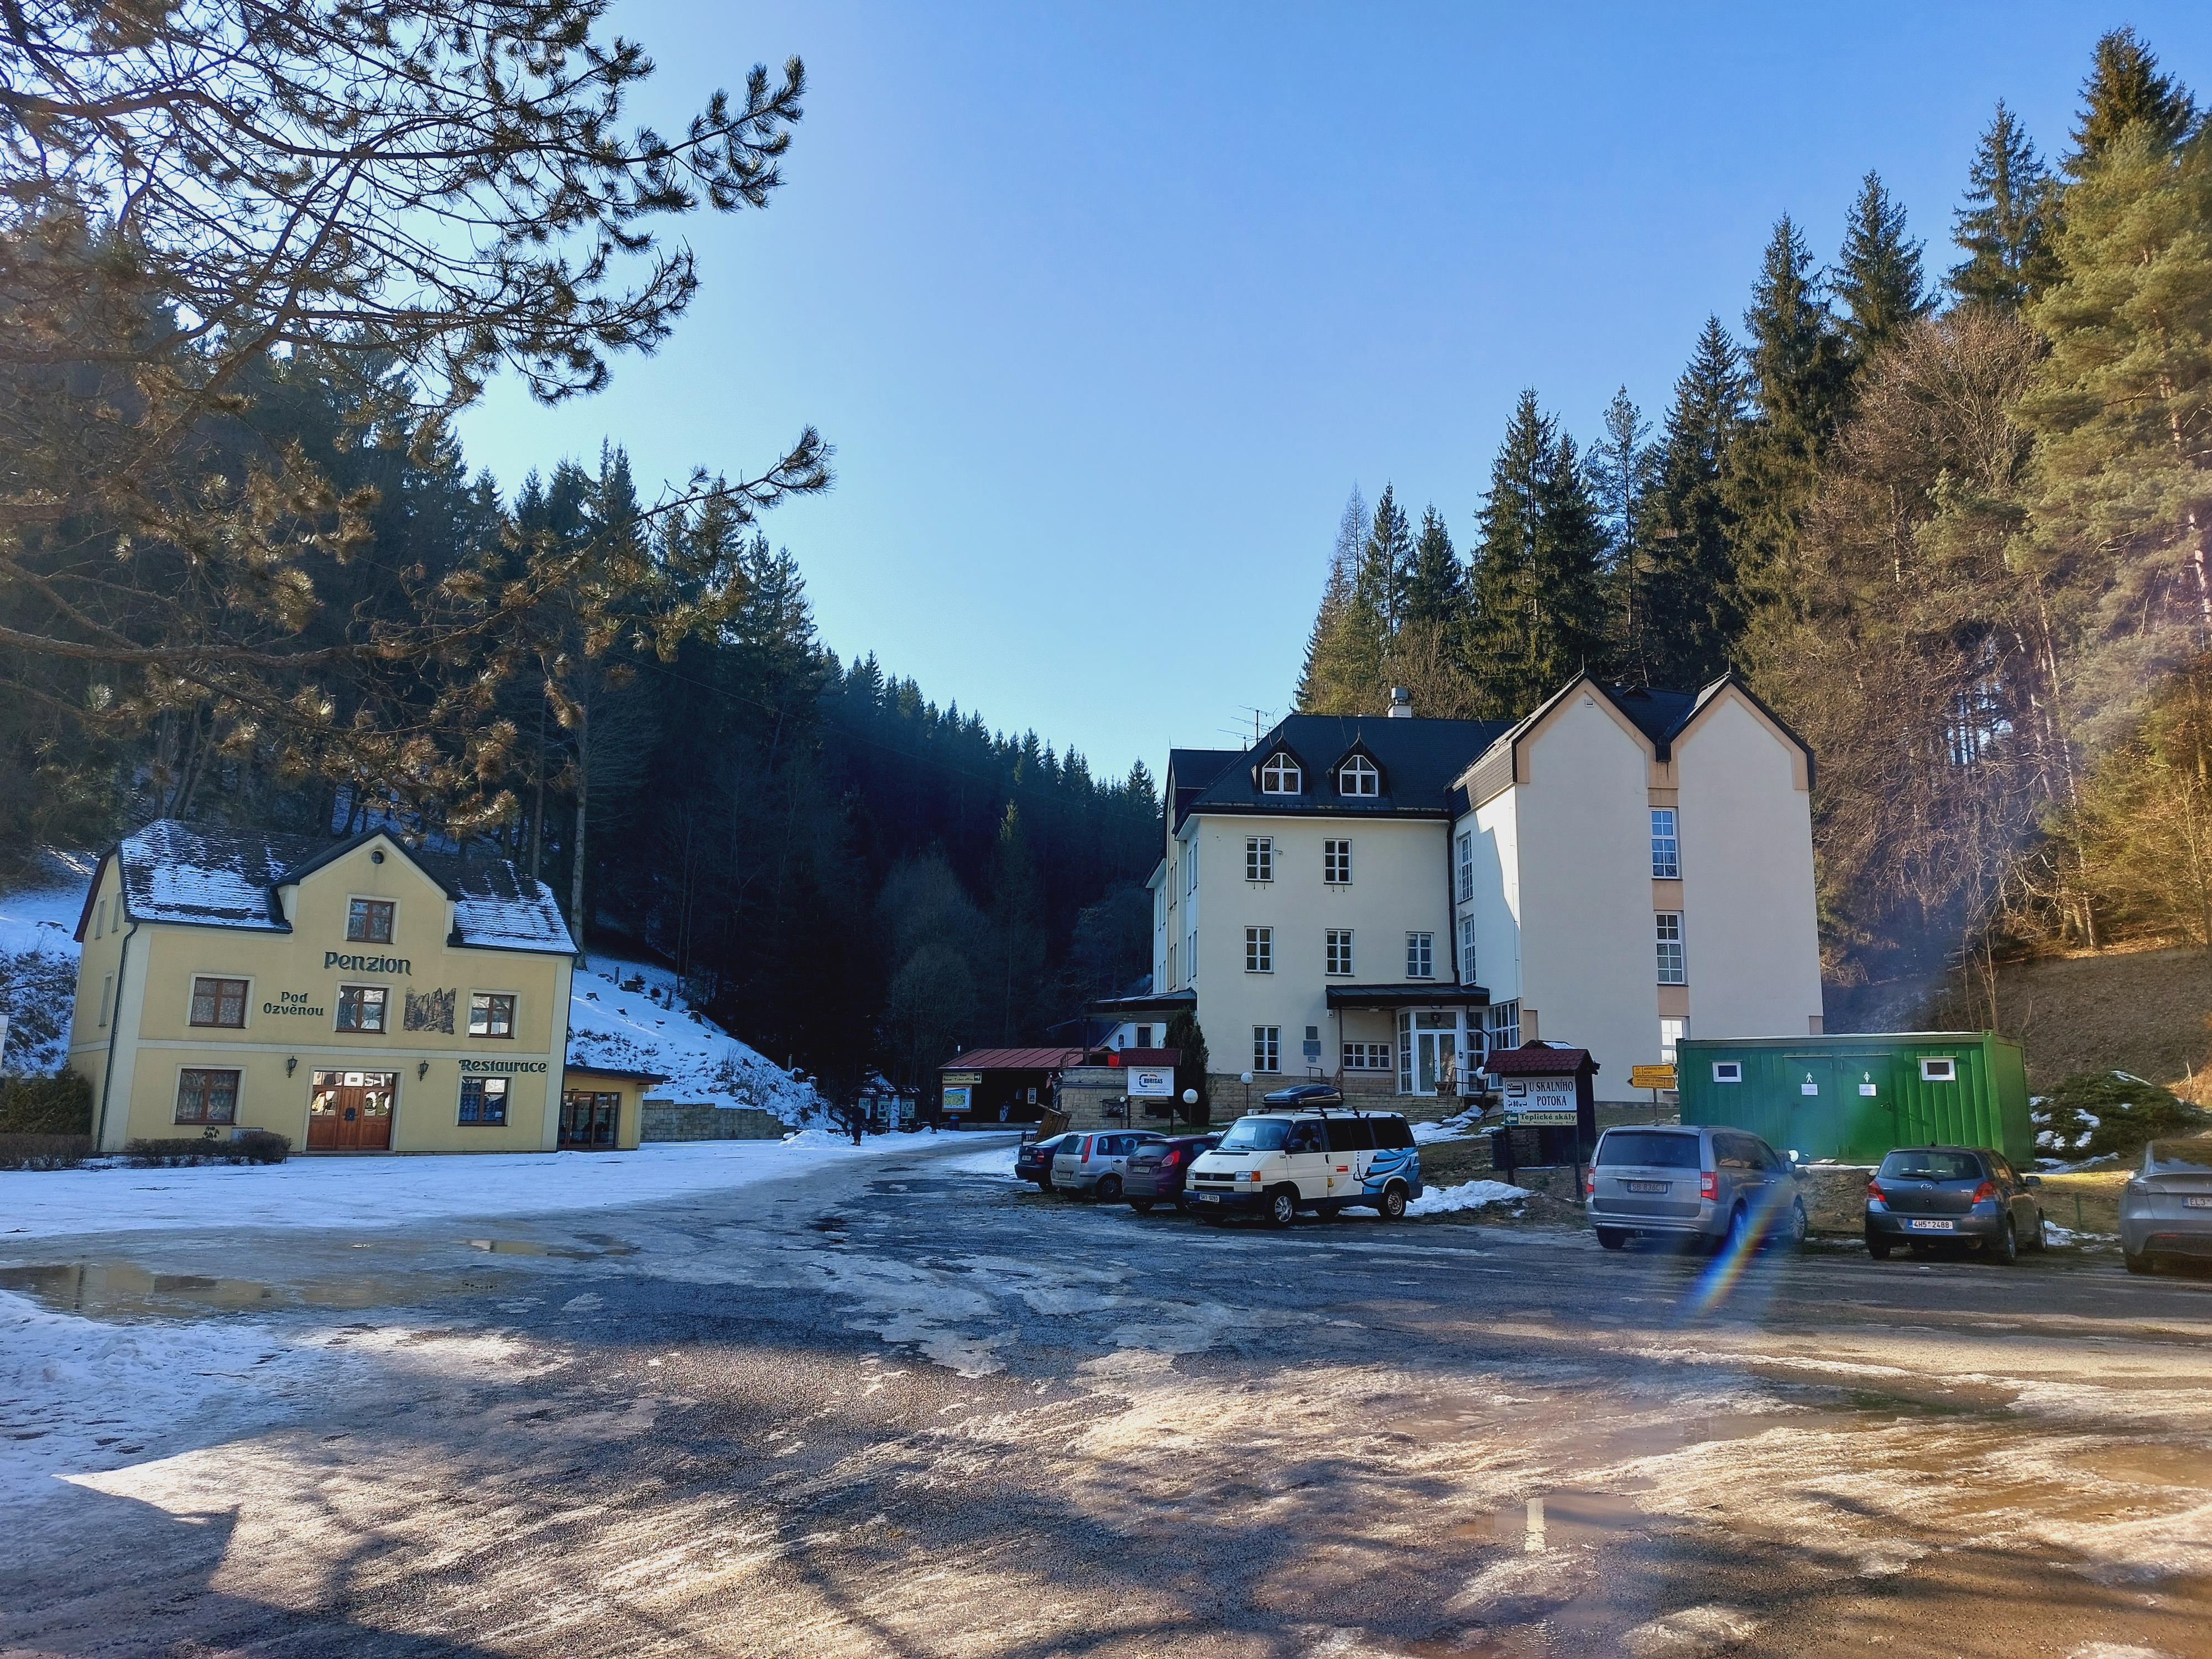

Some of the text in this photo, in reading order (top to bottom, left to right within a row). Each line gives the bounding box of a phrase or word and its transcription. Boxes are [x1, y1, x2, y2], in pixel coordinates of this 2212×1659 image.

[324, 951, 412, 975] Penzion
[281, 992, 308, 1003] Pod
[263, 1003, 324, 1016] Ozvěnou
[458, 1060, 547, 1072] Restaurace
[1529, 1079, 1573, 1092] U SKALNÍHO
[1537, 1095, 1567, 1106] POTOKA
